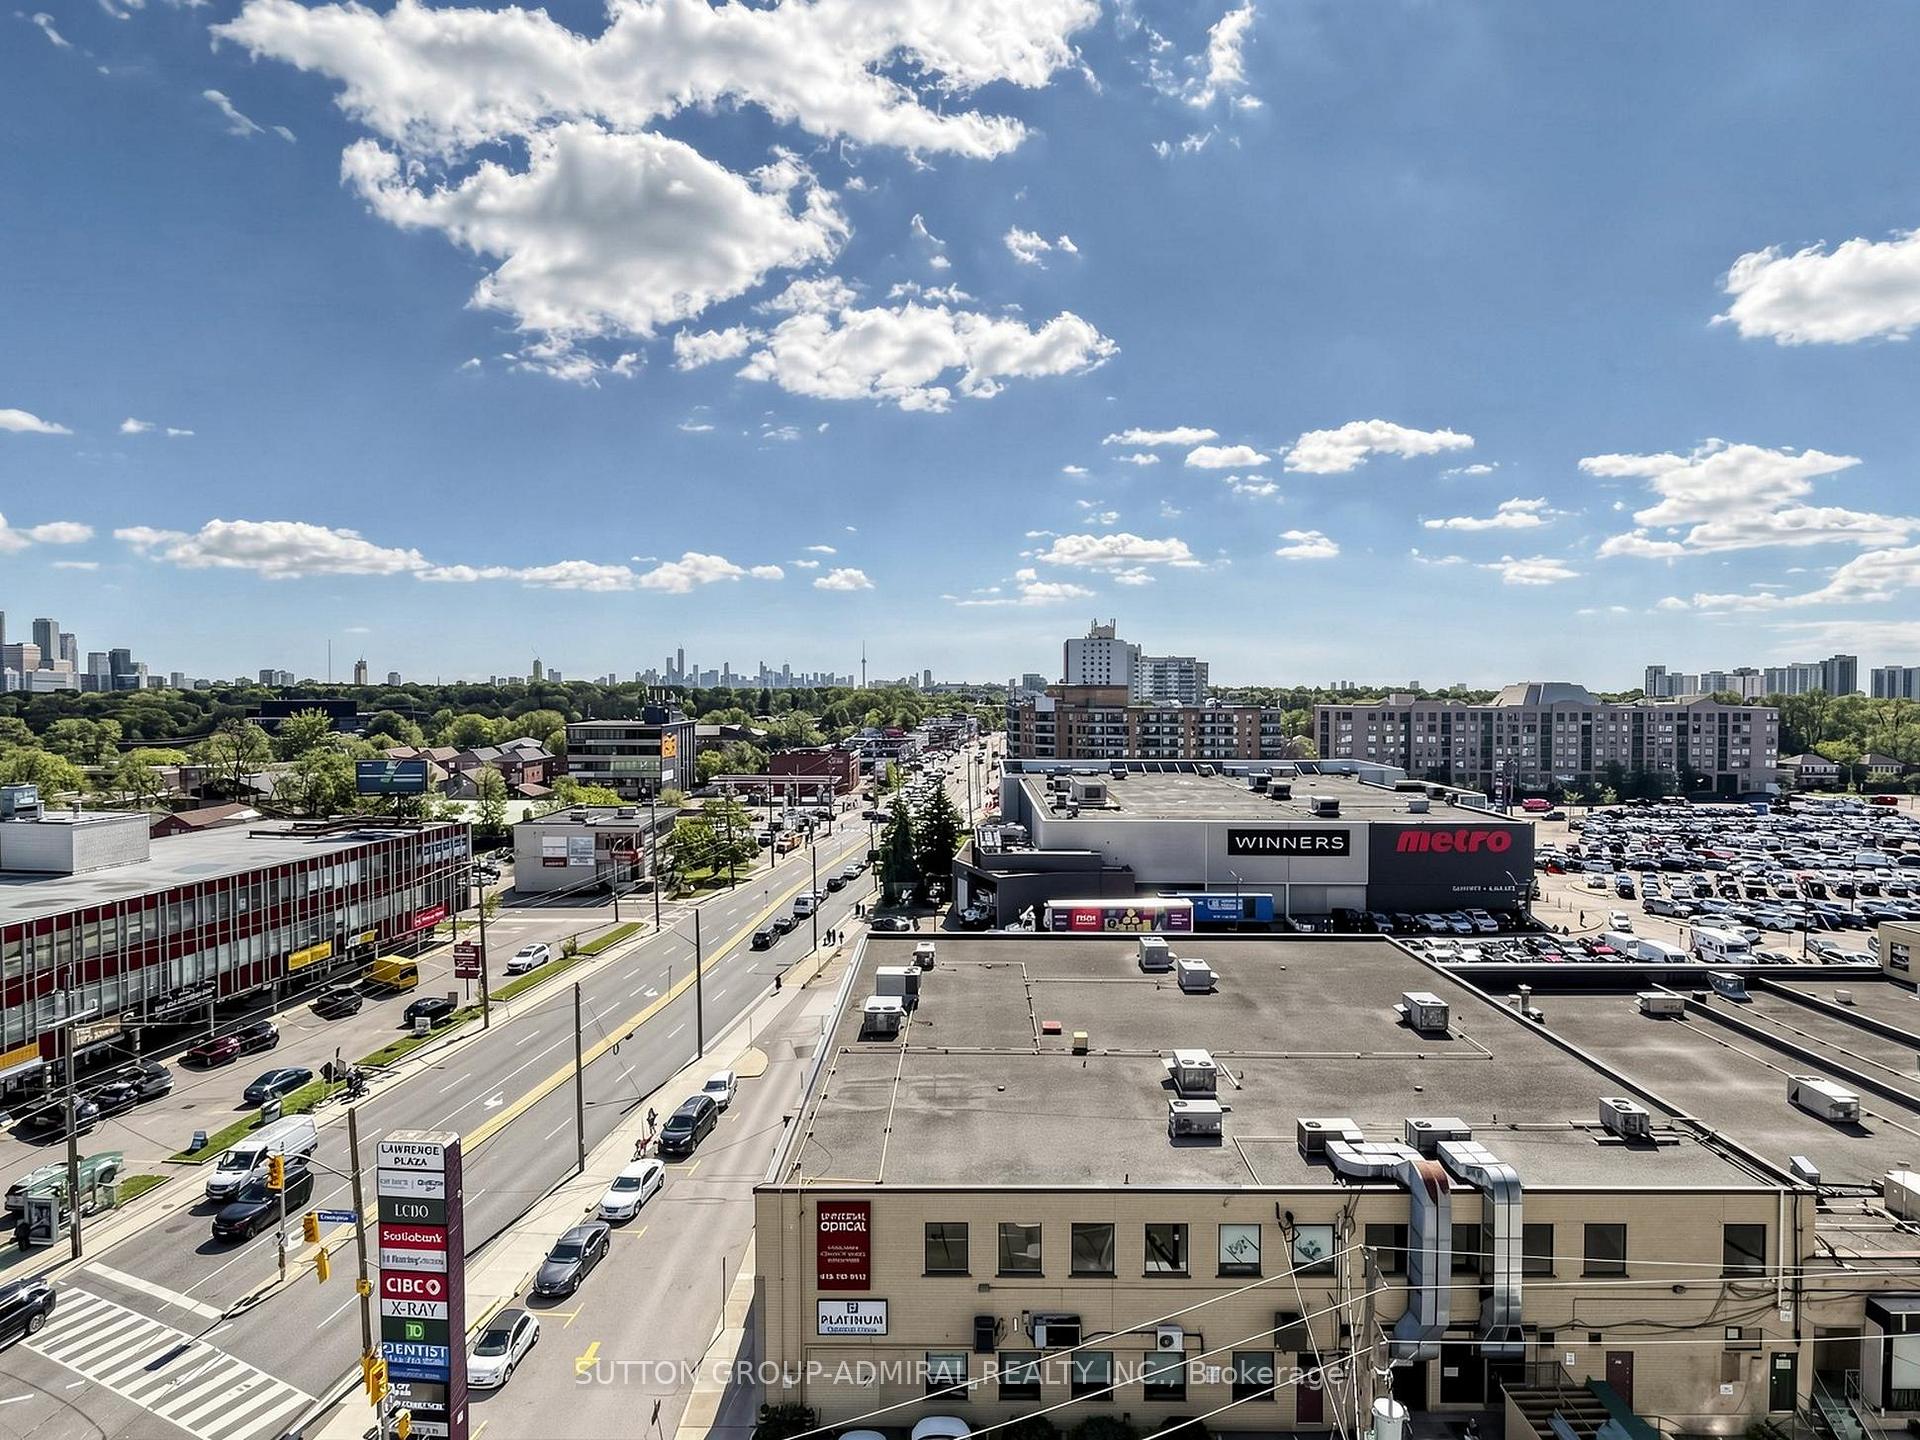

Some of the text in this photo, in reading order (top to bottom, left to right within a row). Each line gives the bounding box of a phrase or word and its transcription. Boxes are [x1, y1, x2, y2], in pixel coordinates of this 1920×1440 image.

[1235, 836, 1344, 849] WINNERS
[1396, 829, 1512, 853] metro
[393, 1157, 427, 1166] PLAZA
[386, 1277, 424, 1293] CIBC
[391, 1301, 437, 1316] X-RAY
[821, 1315, 883, 1325] PLATINUM
[406, 1323, 423, 1338] TD
